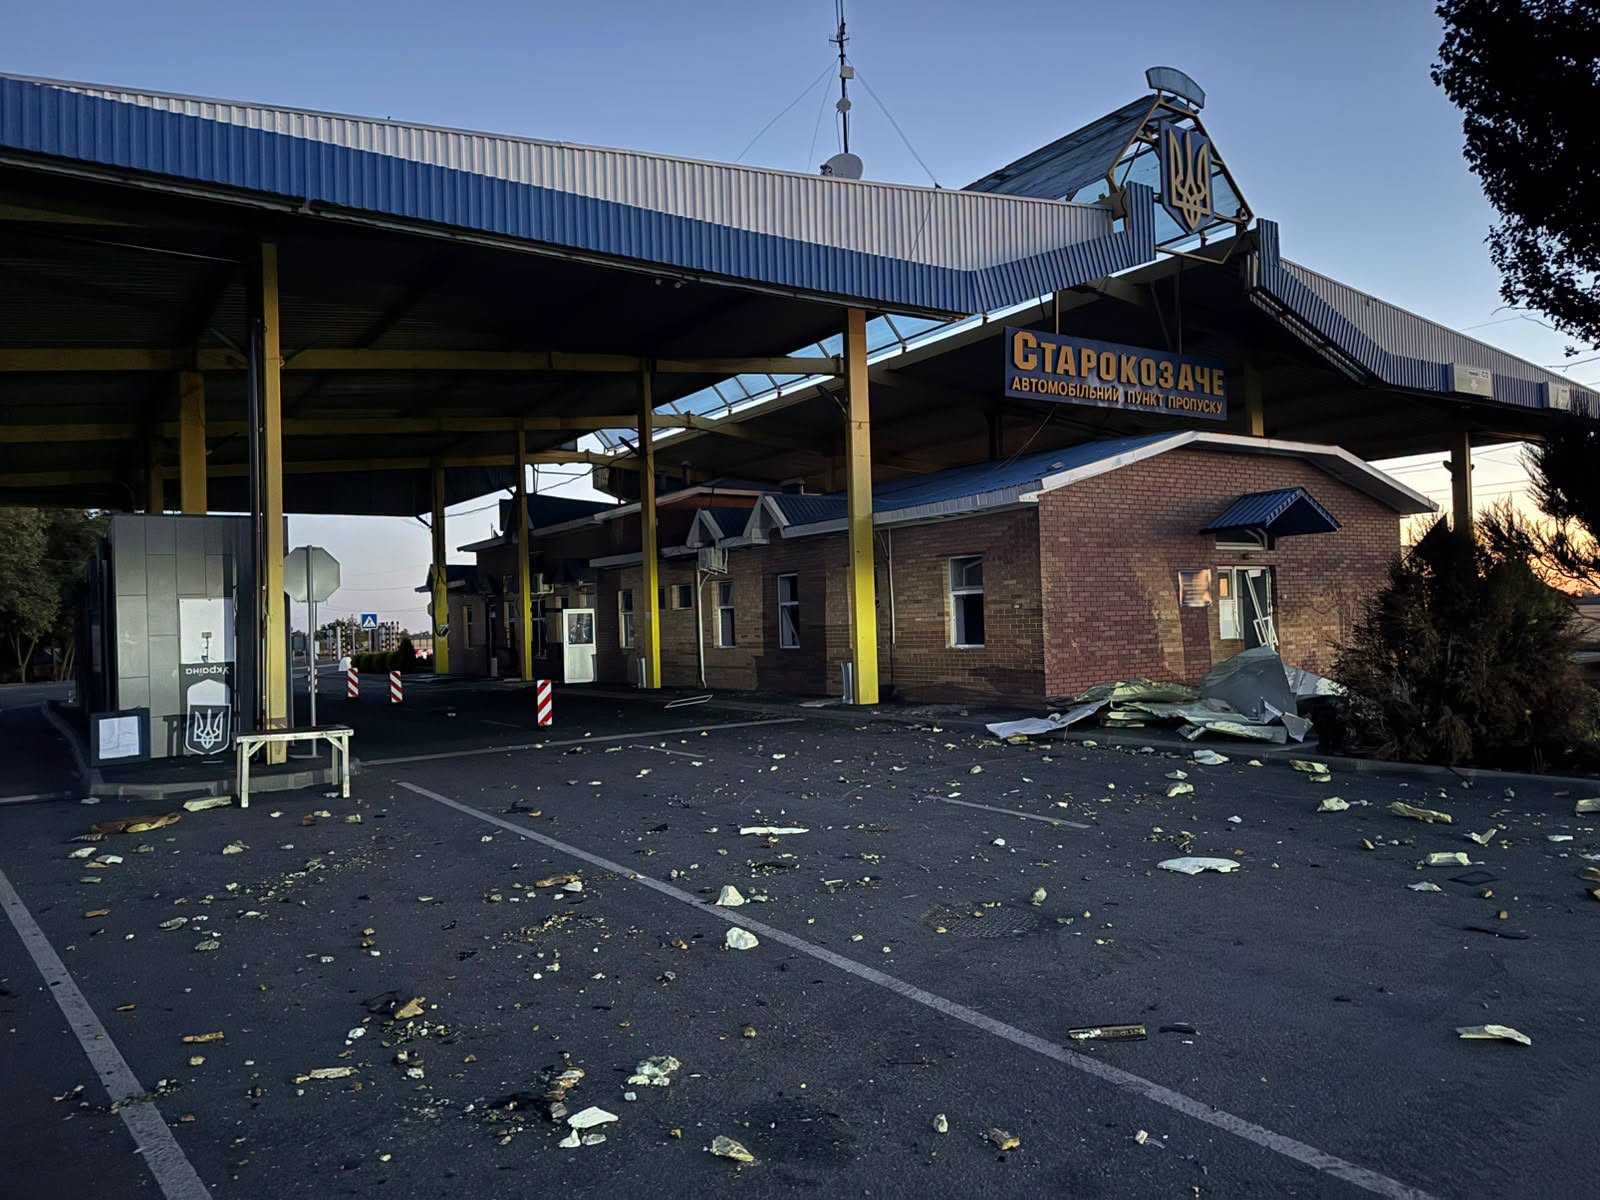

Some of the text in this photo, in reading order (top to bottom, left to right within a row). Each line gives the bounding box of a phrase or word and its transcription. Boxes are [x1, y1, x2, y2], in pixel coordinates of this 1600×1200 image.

[1014, 331, 1224, 396] СТАРОКОЗАЧЕ
[1012, 376, 1223, 414] АВТОМОБІЛЬНИЙ ПУНКТ ПРОПУСКУ
[185, 665, 230, 677] Україна
